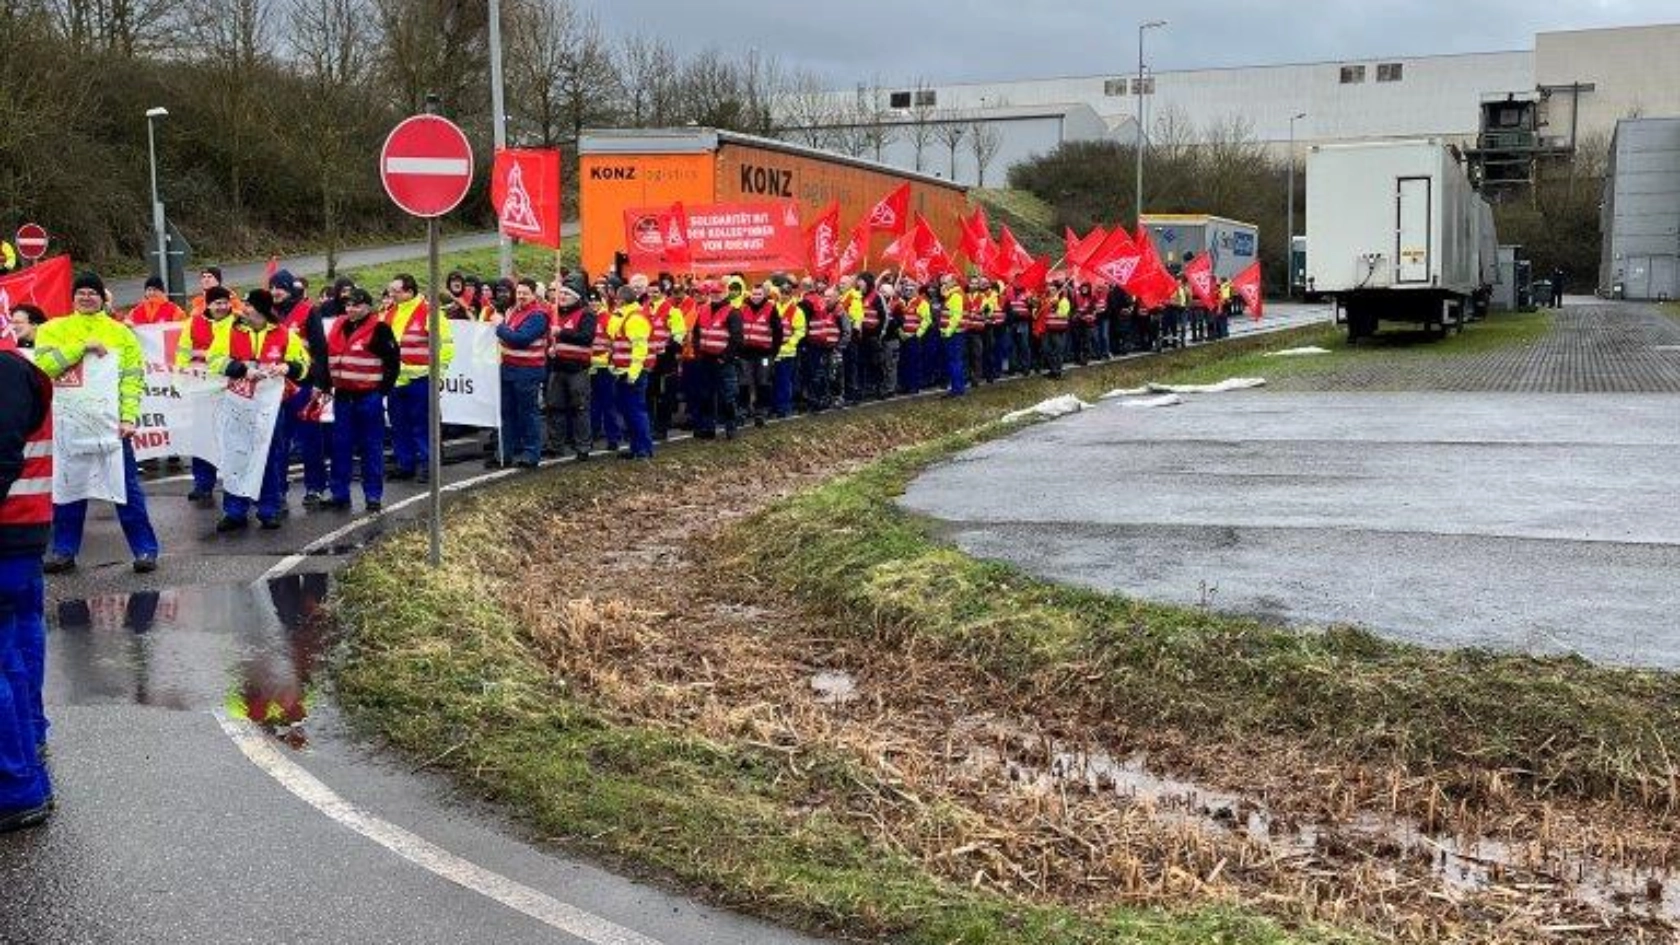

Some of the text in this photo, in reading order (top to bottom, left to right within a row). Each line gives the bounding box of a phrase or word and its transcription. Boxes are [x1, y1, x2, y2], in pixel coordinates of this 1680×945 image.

[590, 166, 635, 180] KONZ
[741, 164, 792, 197] KONZ
[702, 240, 723, 251] VON
